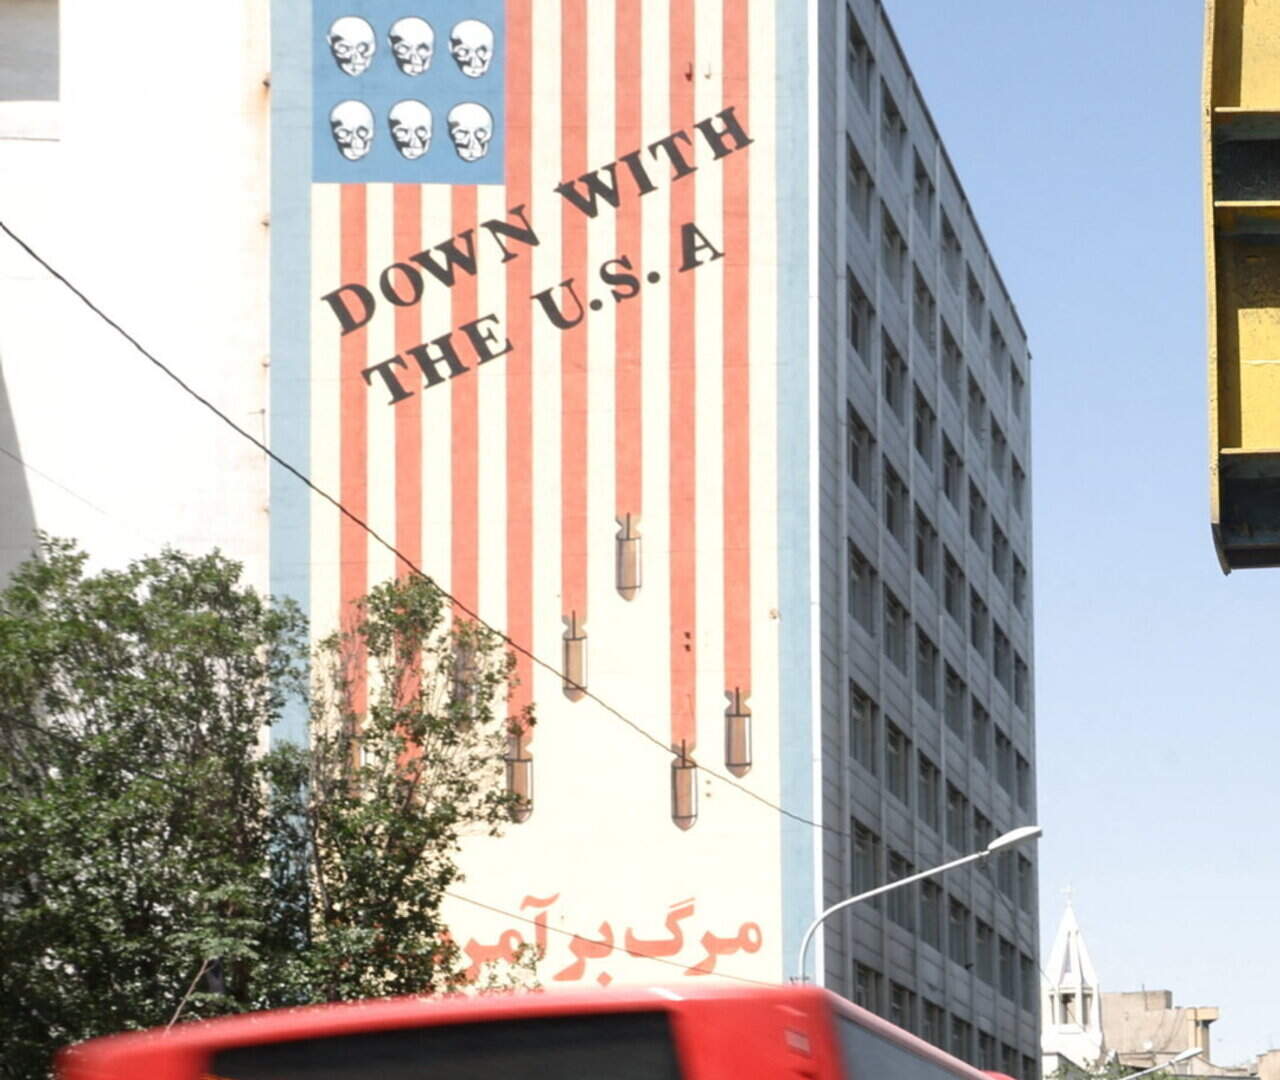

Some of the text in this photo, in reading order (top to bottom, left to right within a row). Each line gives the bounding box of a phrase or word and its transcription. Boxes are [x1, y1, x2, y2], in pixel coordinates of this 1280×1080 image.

[320, 106, 755, 336] DOWN WITH
[361, 313, 514, 406] THE
[553, 921, 615, 987] بر
[624, 897, 763, 977] مرگ
